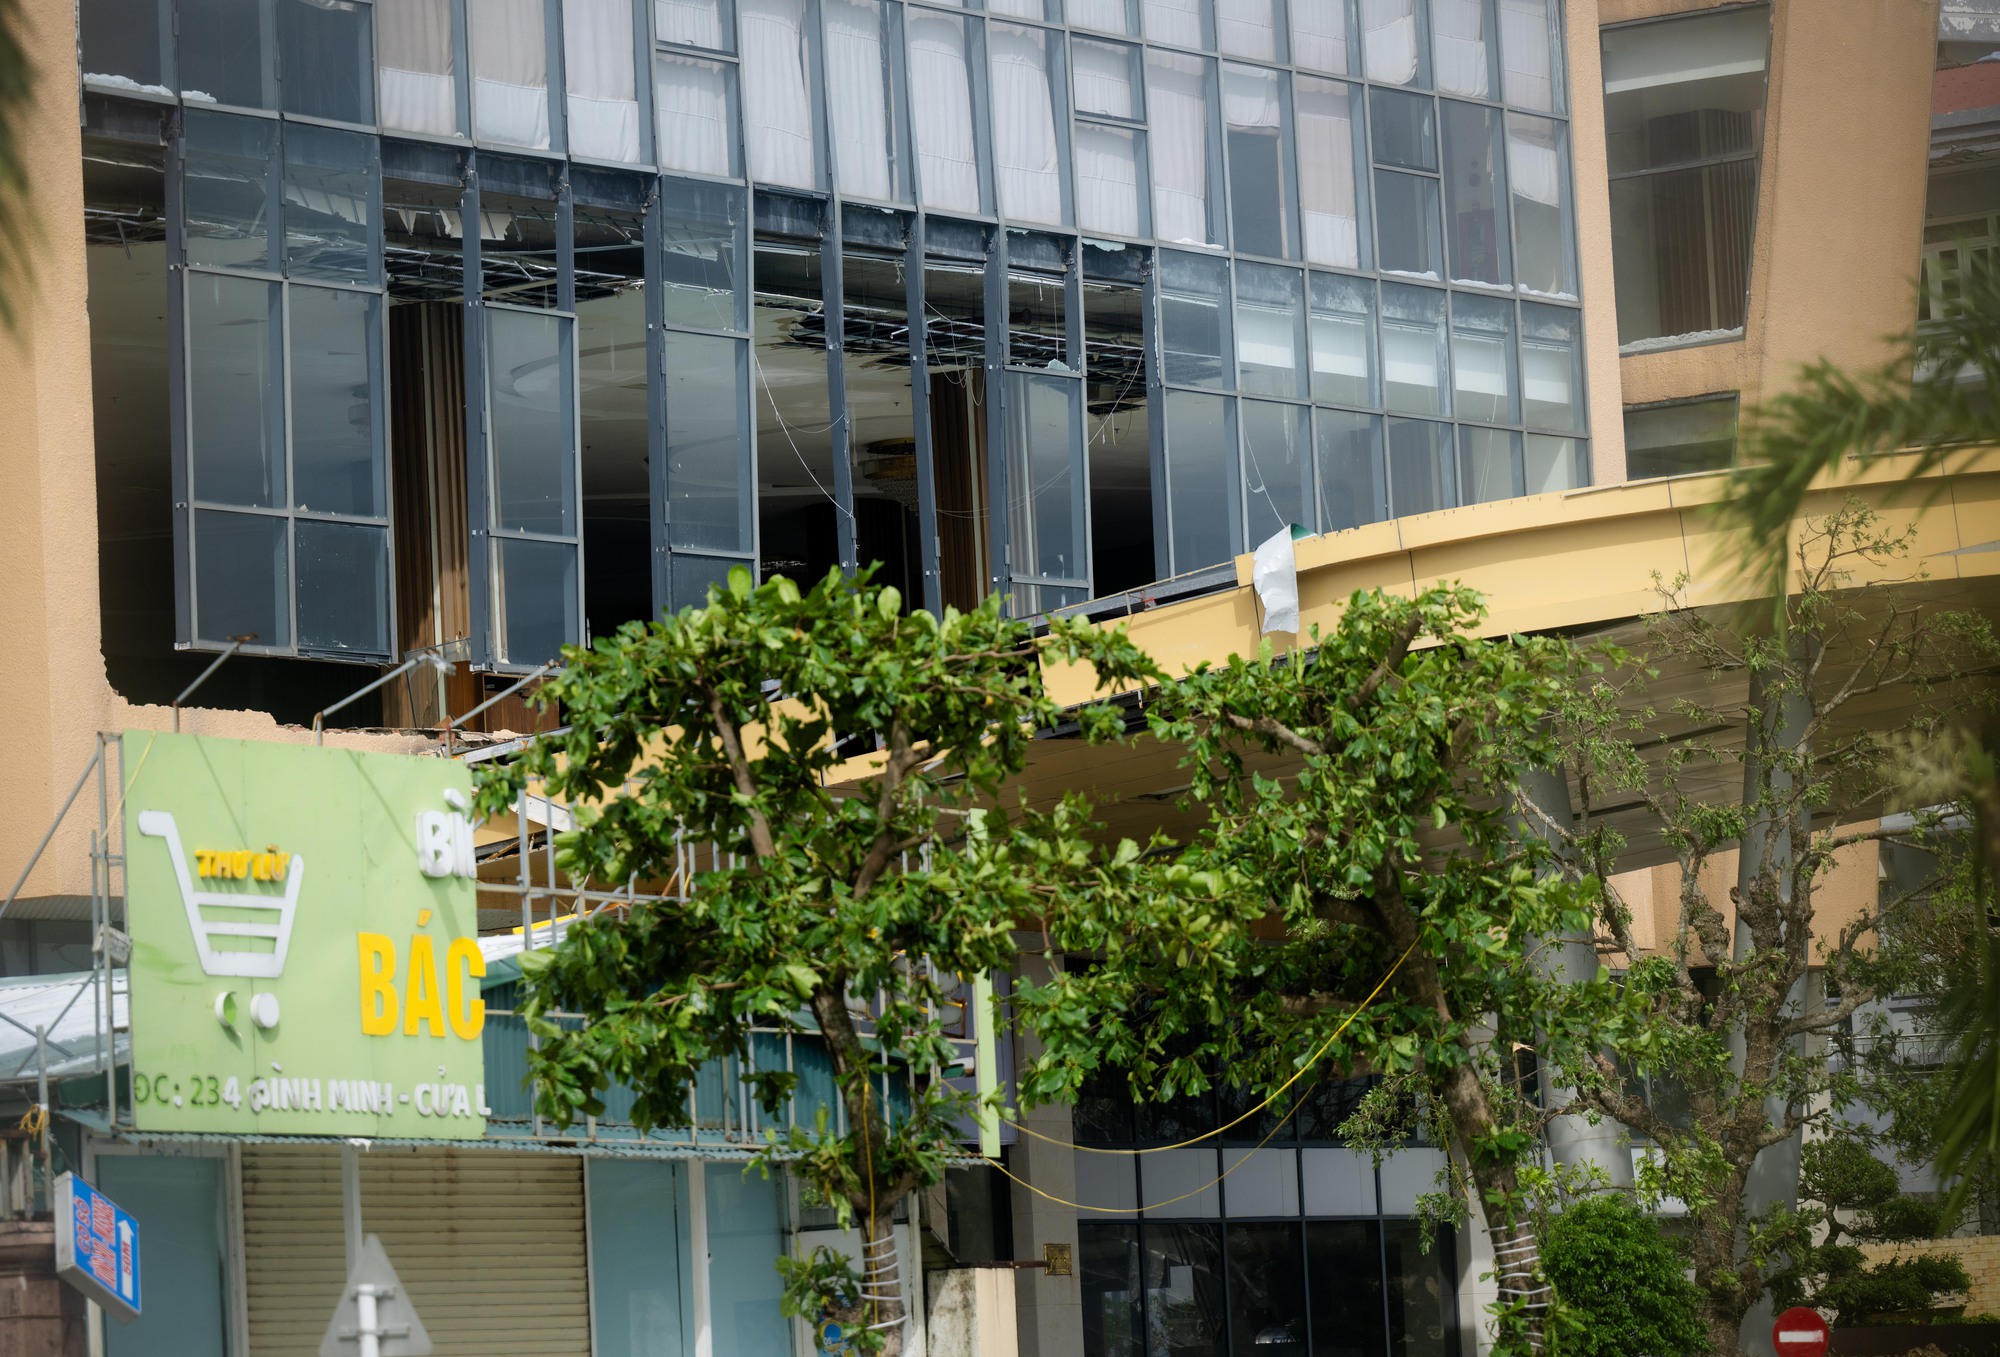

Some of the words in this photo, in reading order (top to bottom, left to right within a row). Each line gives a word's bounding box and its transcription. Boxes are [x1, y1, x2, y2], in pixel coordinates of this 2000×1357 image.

[194, 849, 251, 879] THƯ
[357, 908, 487, 1041] BÁC
[190, 1074, 242, 1111] 234
[328, 1078, 393, 1117] MINH
[414, 1063, 471, 1119] CỬA
